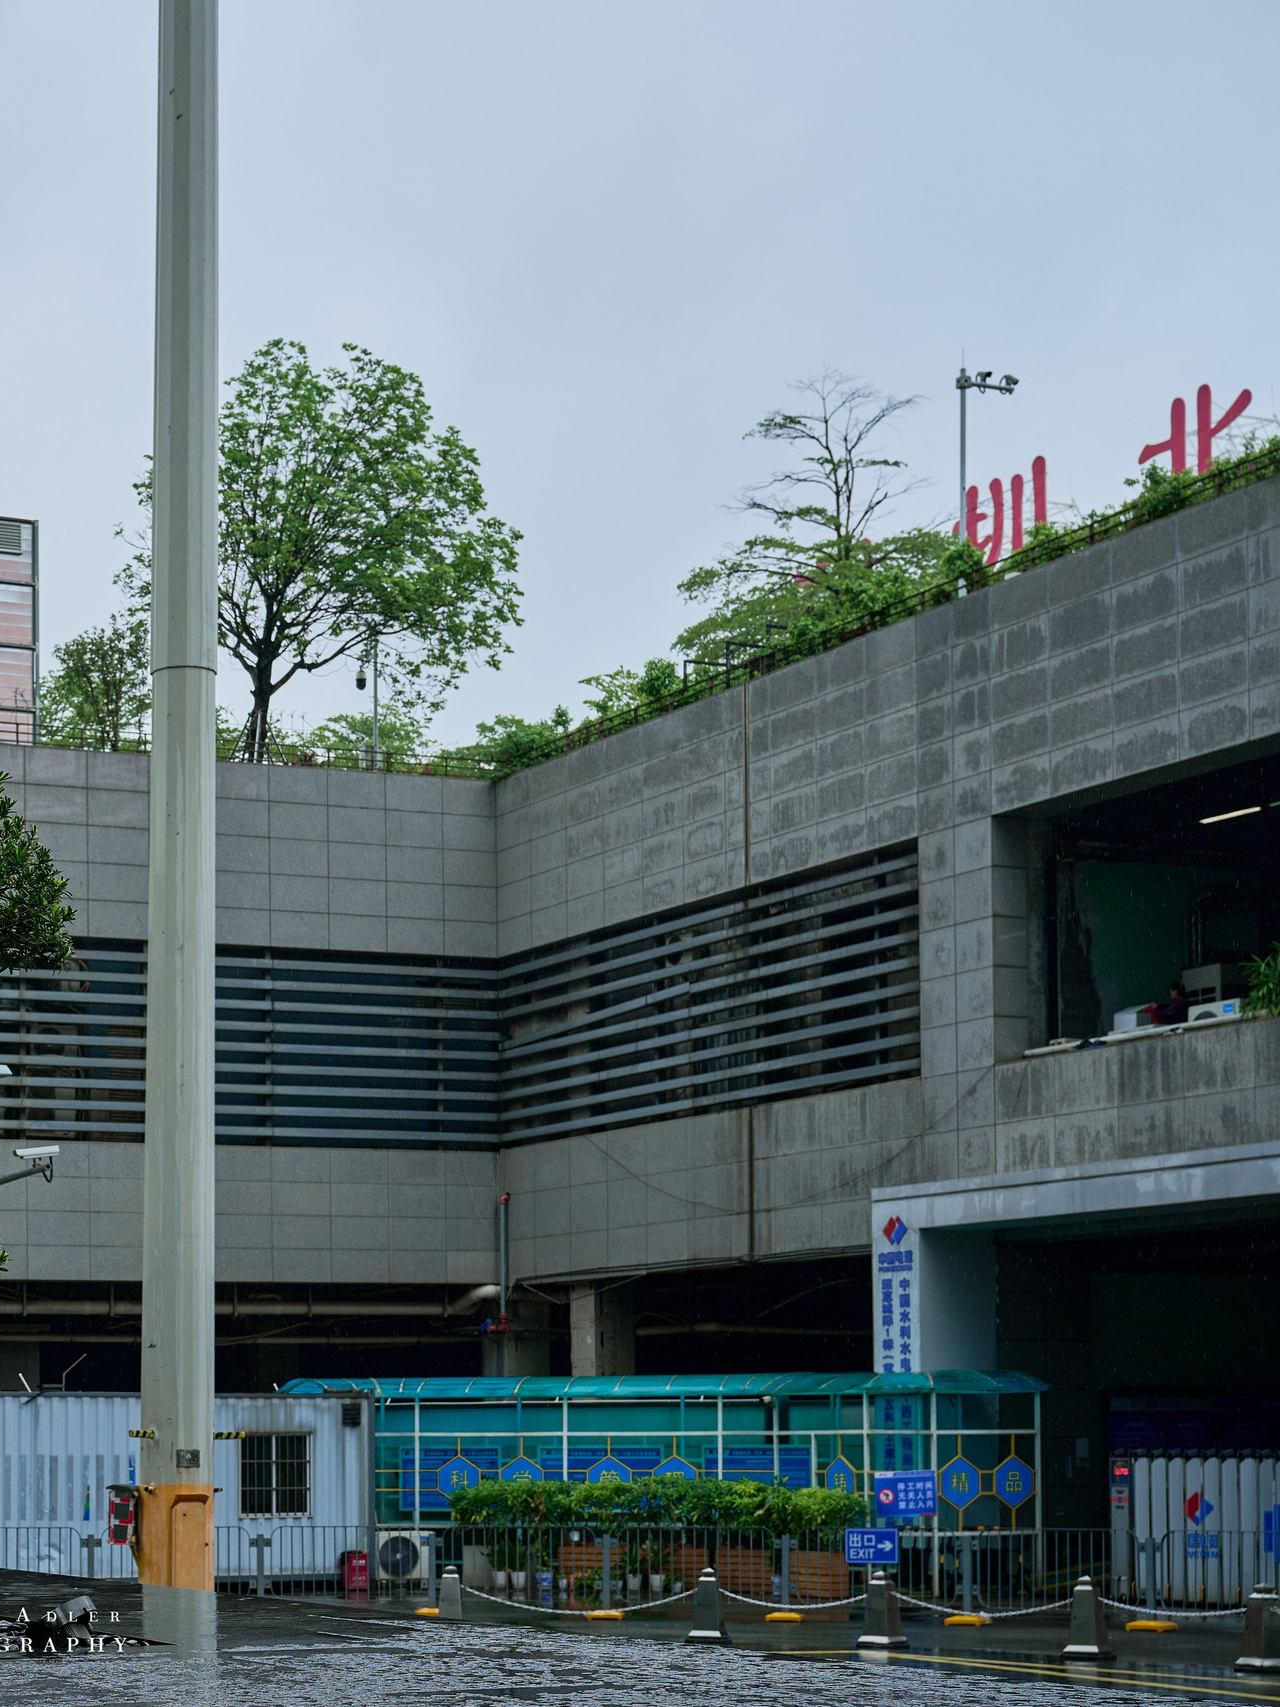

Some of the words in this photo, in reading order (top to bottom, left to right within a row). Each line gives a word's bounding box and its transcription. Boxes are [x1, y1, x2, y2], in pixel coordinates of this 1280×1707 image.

[897, 1481, 933, 1491] 停工时间
[898, 1490, 933, 1500] 无关人员
[898, 1499, 934, 1510] 禁止入内
[849, 1533, 875, 1547] 出口
[849, 1548, 875, 1560] EXIT
